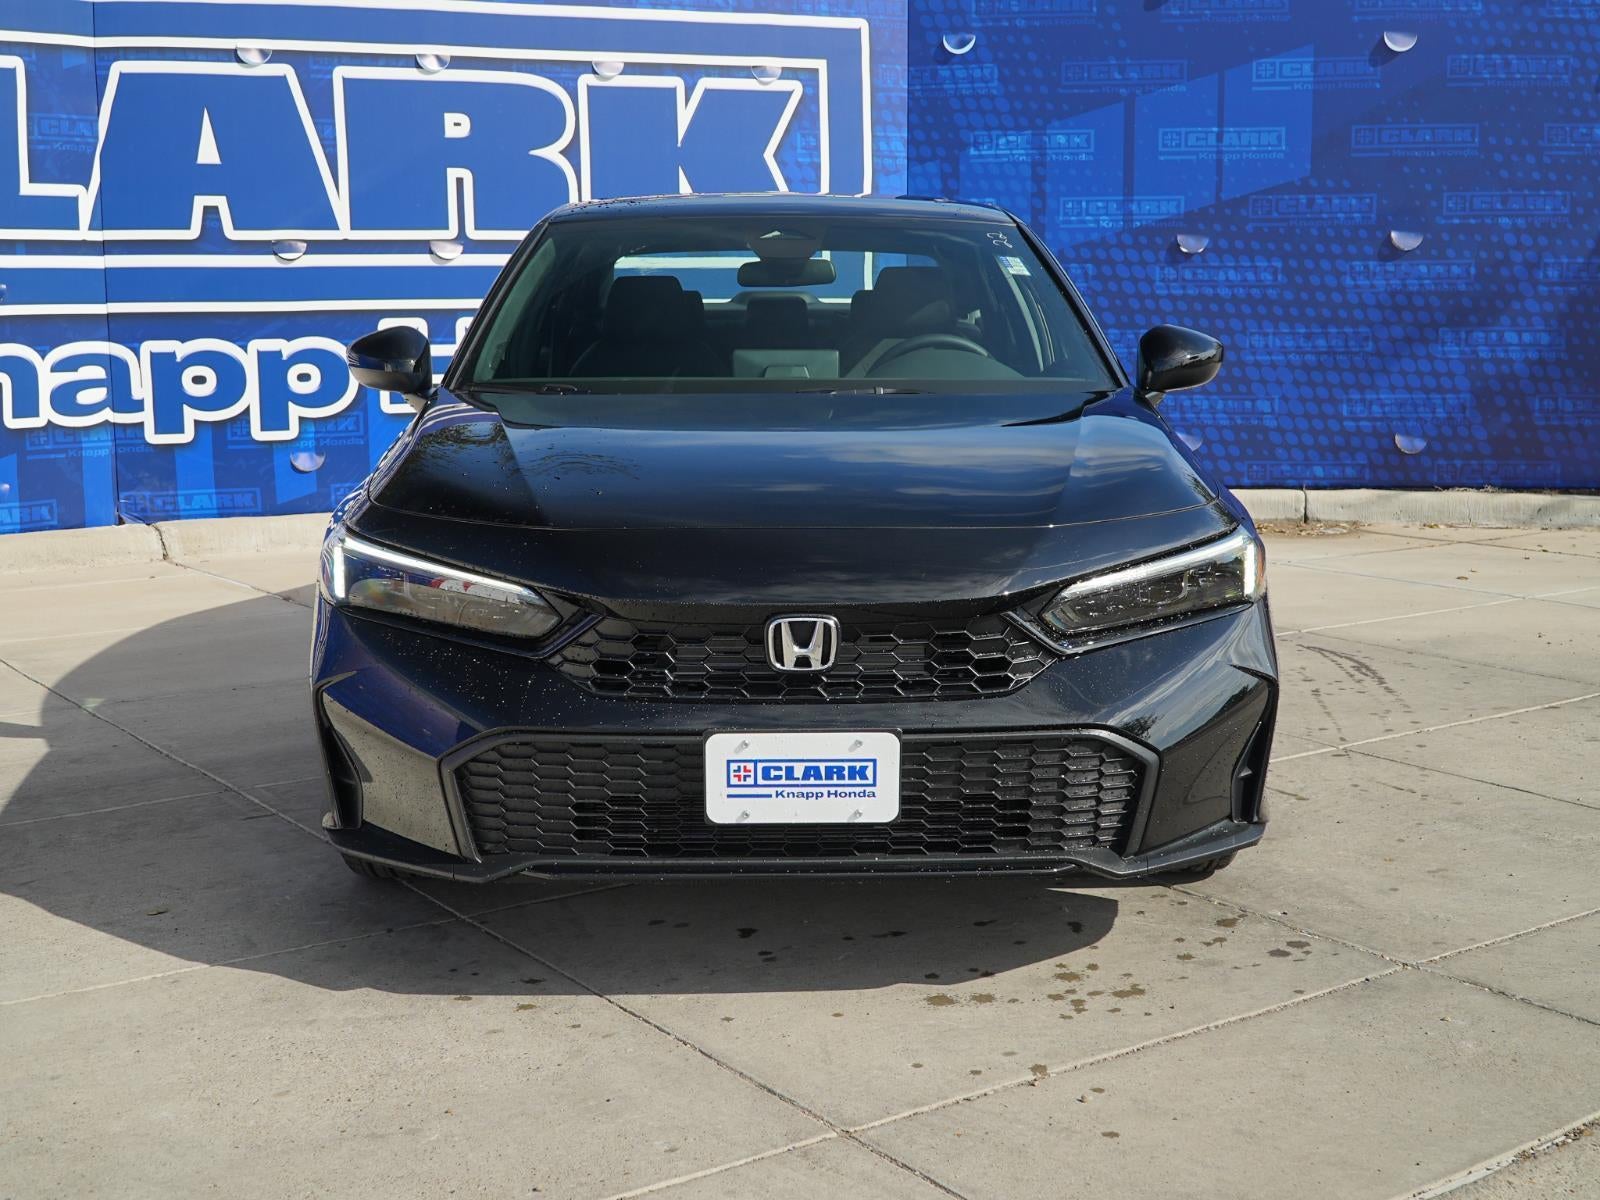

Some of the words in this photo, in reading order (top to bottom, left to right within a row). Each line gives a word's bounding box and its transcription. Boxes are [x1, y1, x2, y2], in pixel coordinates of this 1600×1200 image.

[1187, 131, 1281, 146] CLARK
[761, 765, 870, 782] CLARK
[775, 789, 824, 800] Knapp
[827, 789, 876, 799] Honda
